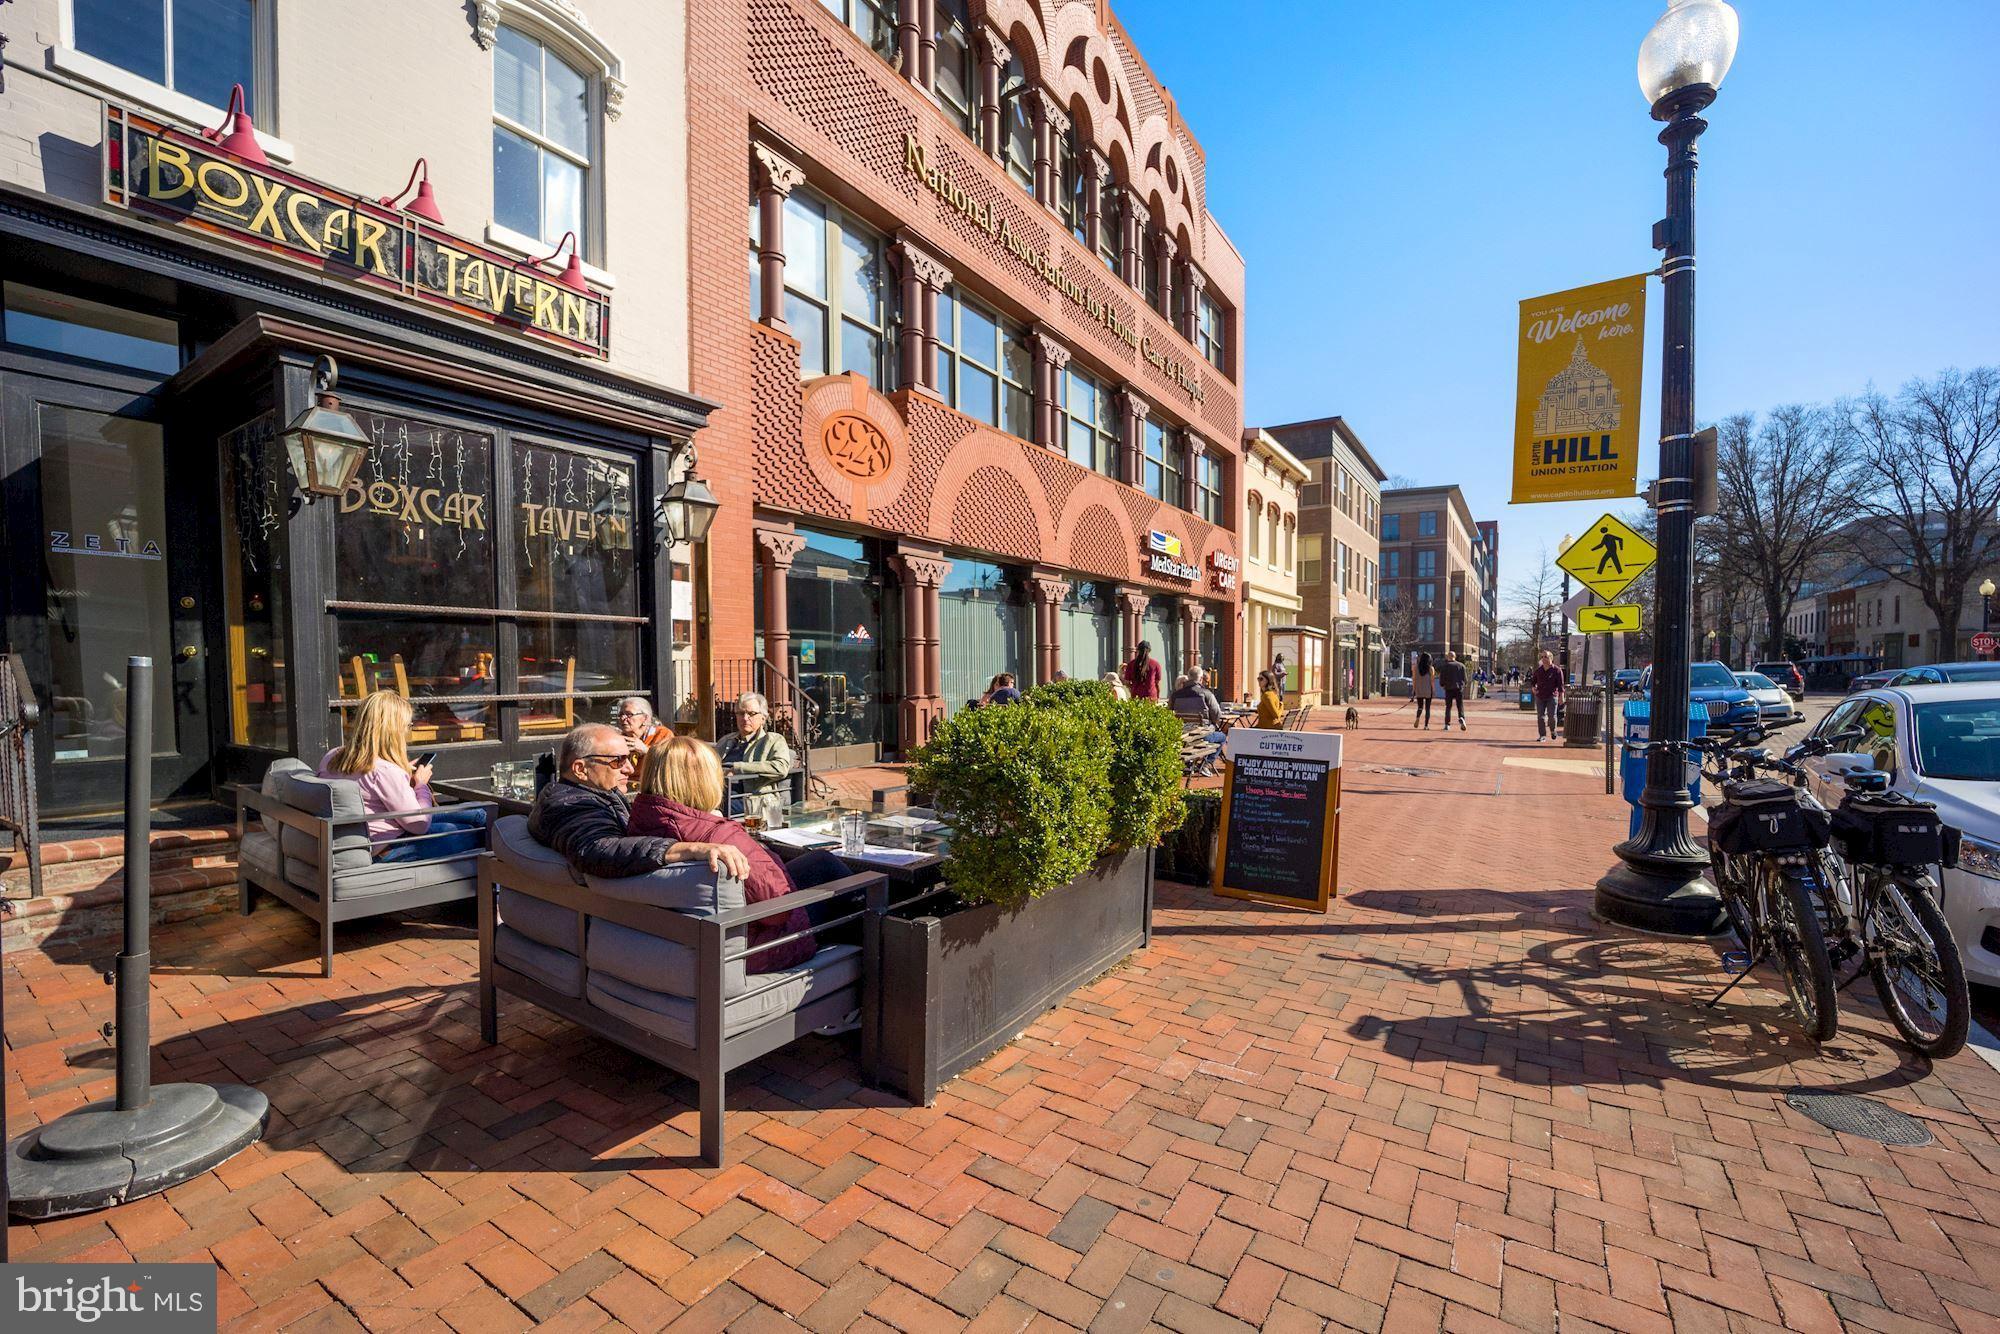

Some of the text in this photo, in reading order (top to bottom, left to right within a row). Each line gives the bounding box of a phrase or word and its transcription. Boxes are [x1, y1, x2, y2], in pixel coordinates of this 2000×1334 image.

[147, 136, 587, 341] BOXCAR TAVERN
[904, 133, 995, 235] National
[999, 218, 1083, 304] Association
[1086, 286, 1103, 320] for
[1107, 304, 1138, 347] Home
[1142, 336, 1166, 370] Care
[1166, 361, 1177, 378] &
[1527, 303, 1631, 344] Welcome
[1531, 306, 1566, 318] YOU ARE
[1531, 441, 1542, 466] CAPITOL
[1543, 435, 1619, 465] HILL
[1531, 463, 1618, 477] UNION STATION
[340, 478, 485, 530] BOXCAR
[51, 531, 161, 555] ZETA
[1213, 550, 1239, 572] URGENT
[1219, 571, 1236, 590] CARE
[1259, 741, 1303, 753] CUTWATER
[1237, 758, 1326, 773] ENJOY AWARD-WINNING
[1243, 767, 1318, 781] COCKTAILS IN A CAN
